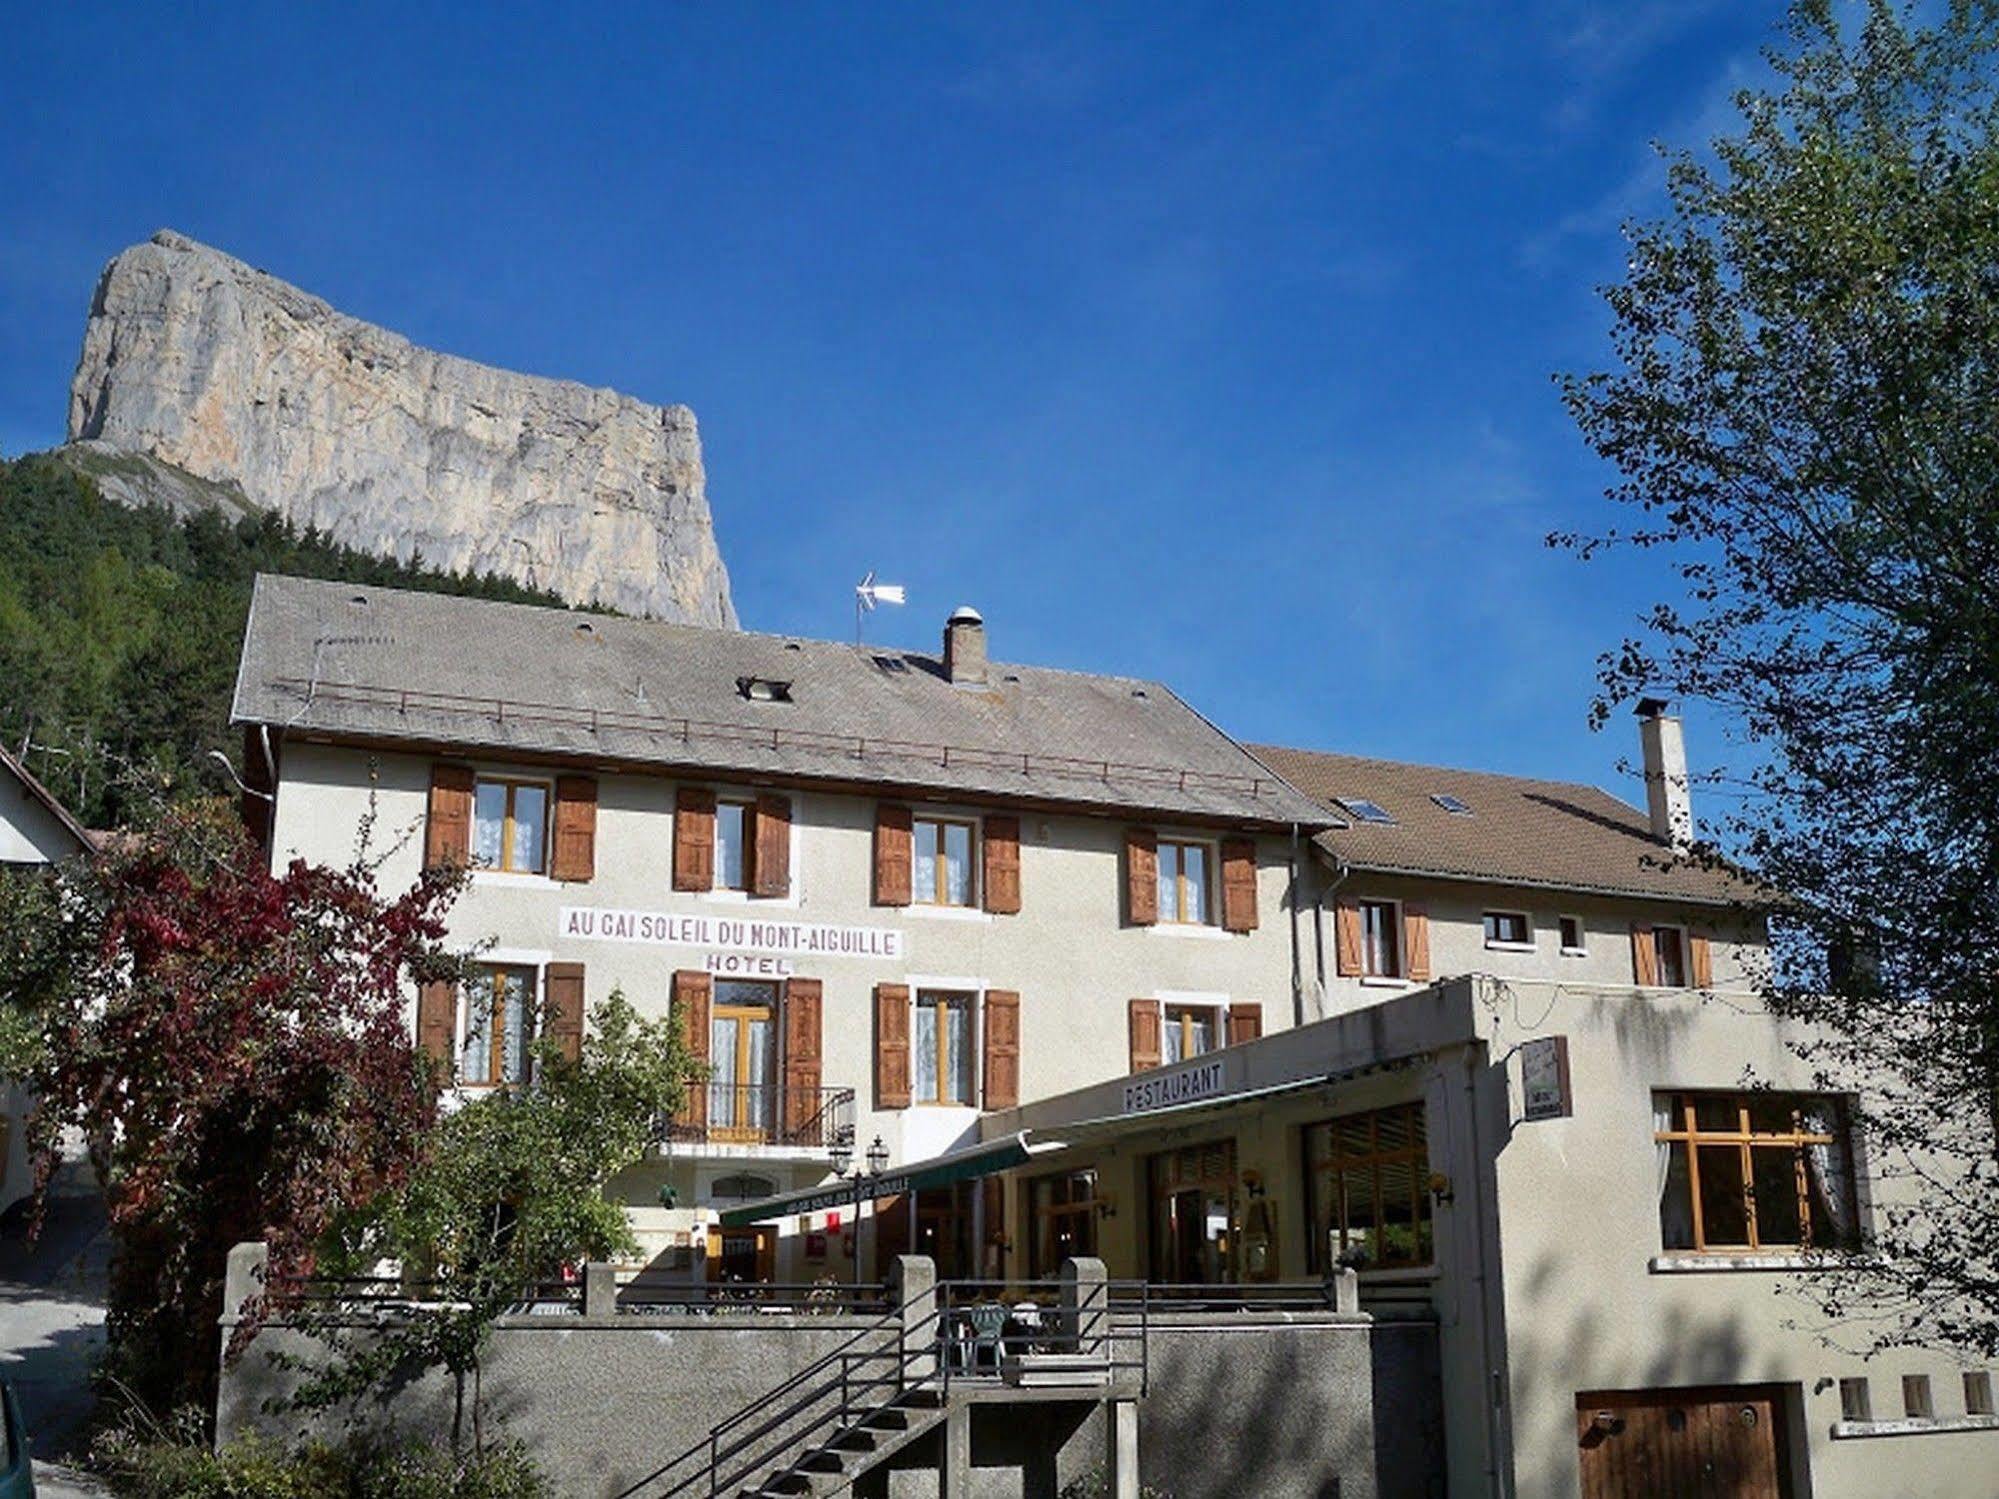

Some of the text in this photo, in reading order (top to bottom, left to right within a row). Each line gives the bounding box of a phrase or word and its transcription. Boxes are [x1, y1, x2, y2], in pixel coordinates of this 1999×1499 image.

[568, 911, 896, 955] AU GAI SOLEIL DU MONT-AIGUILLE
[706, 954, 790, 975] HOTEL
[1125, 1064, 1220, 1111] RESTAURANT
